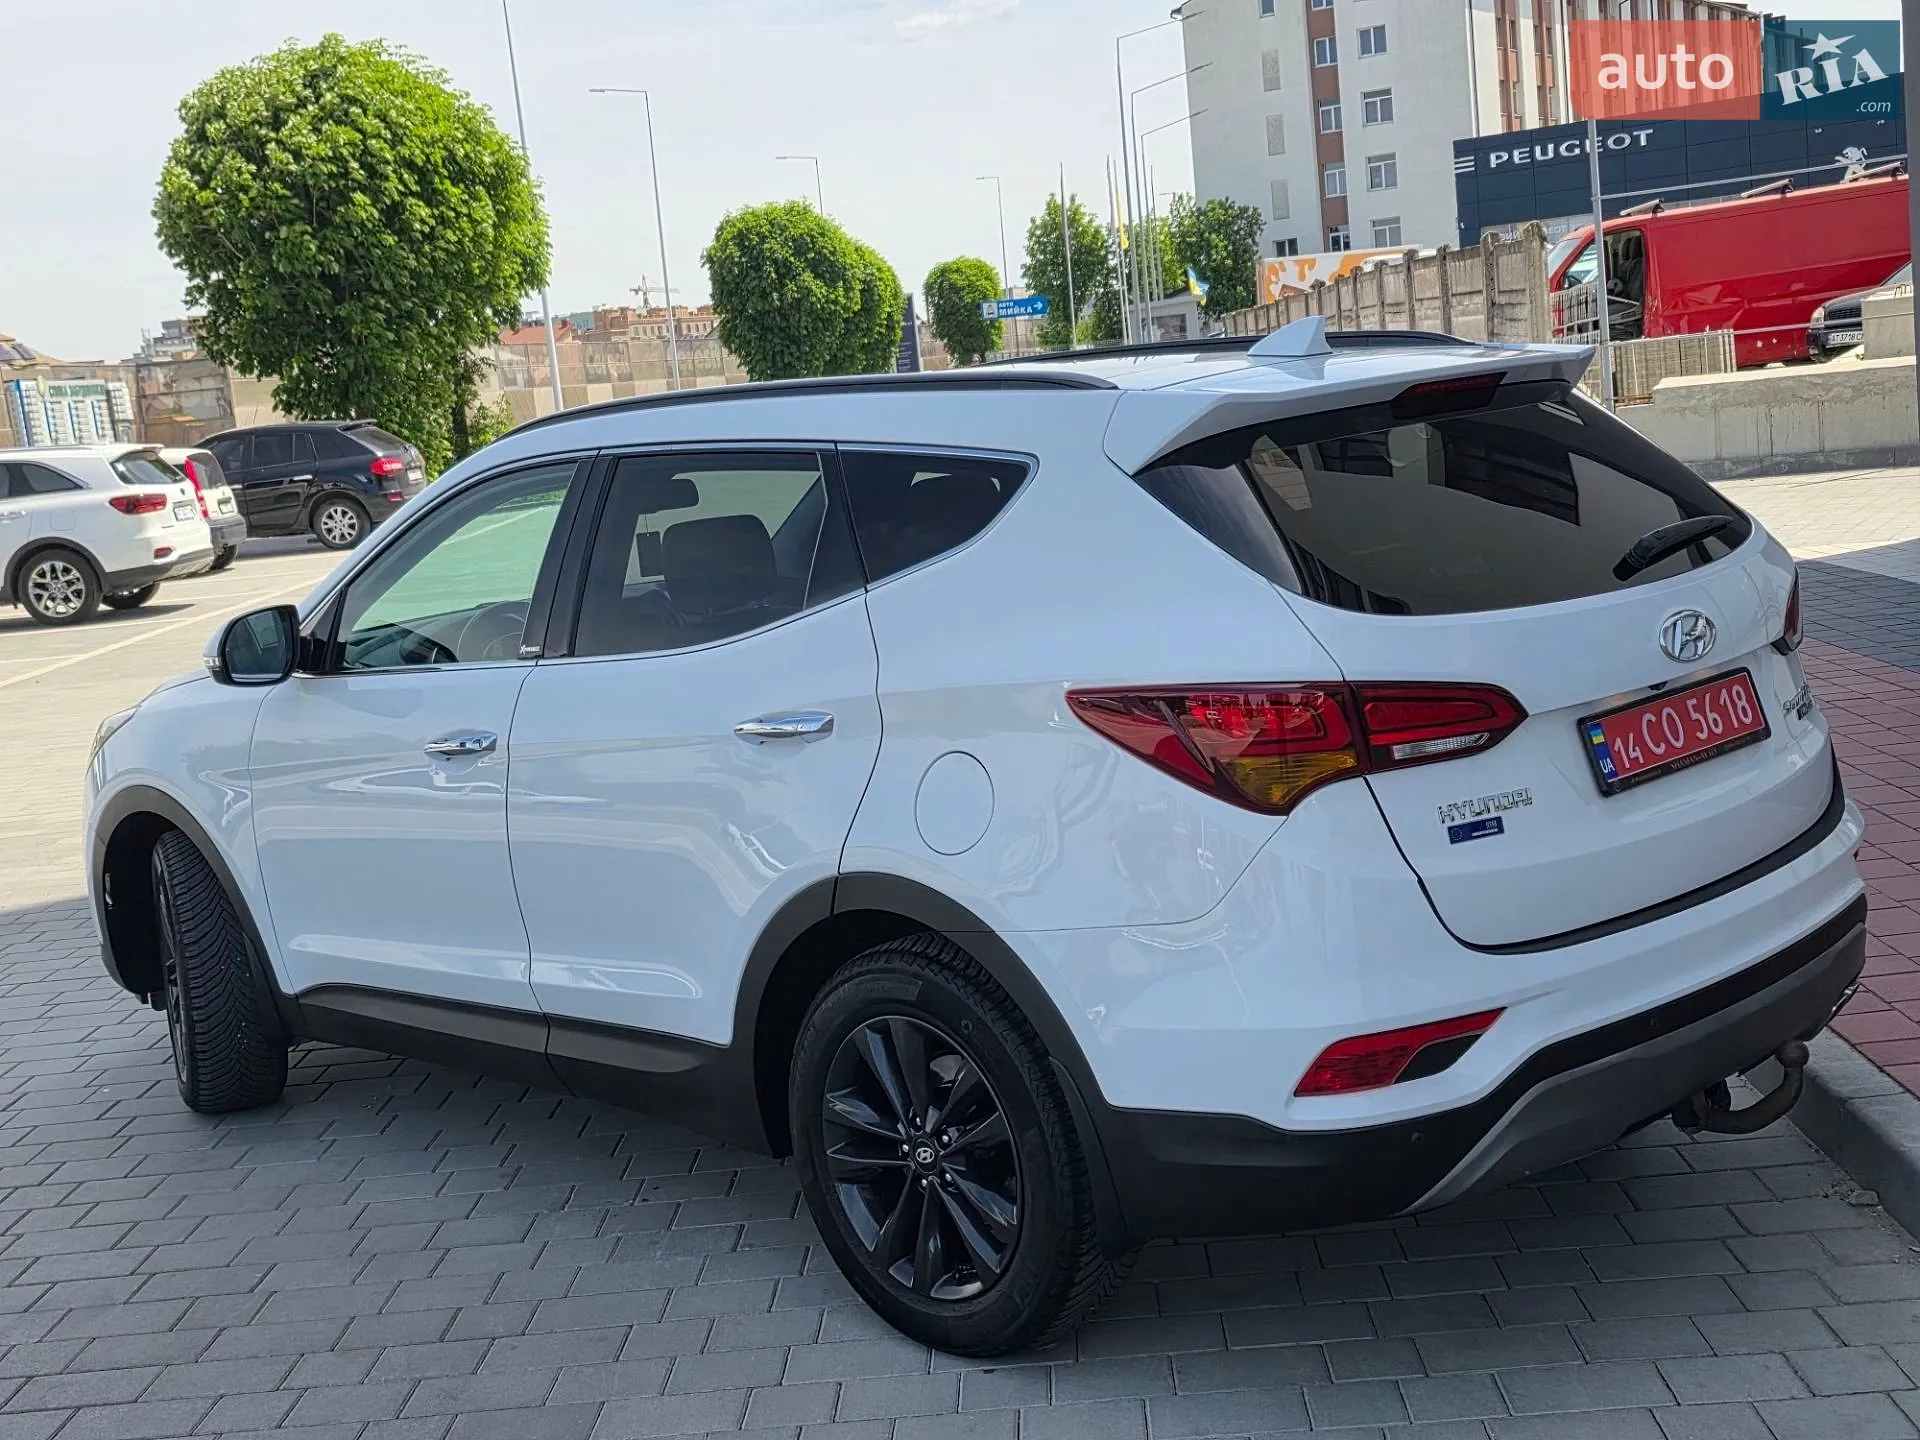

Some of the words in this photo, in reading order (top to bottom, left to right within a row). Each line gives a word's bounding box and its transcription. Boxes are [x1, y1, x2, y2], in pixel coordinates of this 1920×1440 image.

[1490, 129, 1654, 168] PEUGEOT
[999, 305, 1033, 316] МИЙКА
[1614, 732, 1645, 769] 14
[1641, 707, 1685, 756] CO
[1686, 684, 1753, 741] 5618
[1600, 759, 1615, 774] UA
[1437, 787, 1533, 825] HYUNDAI
